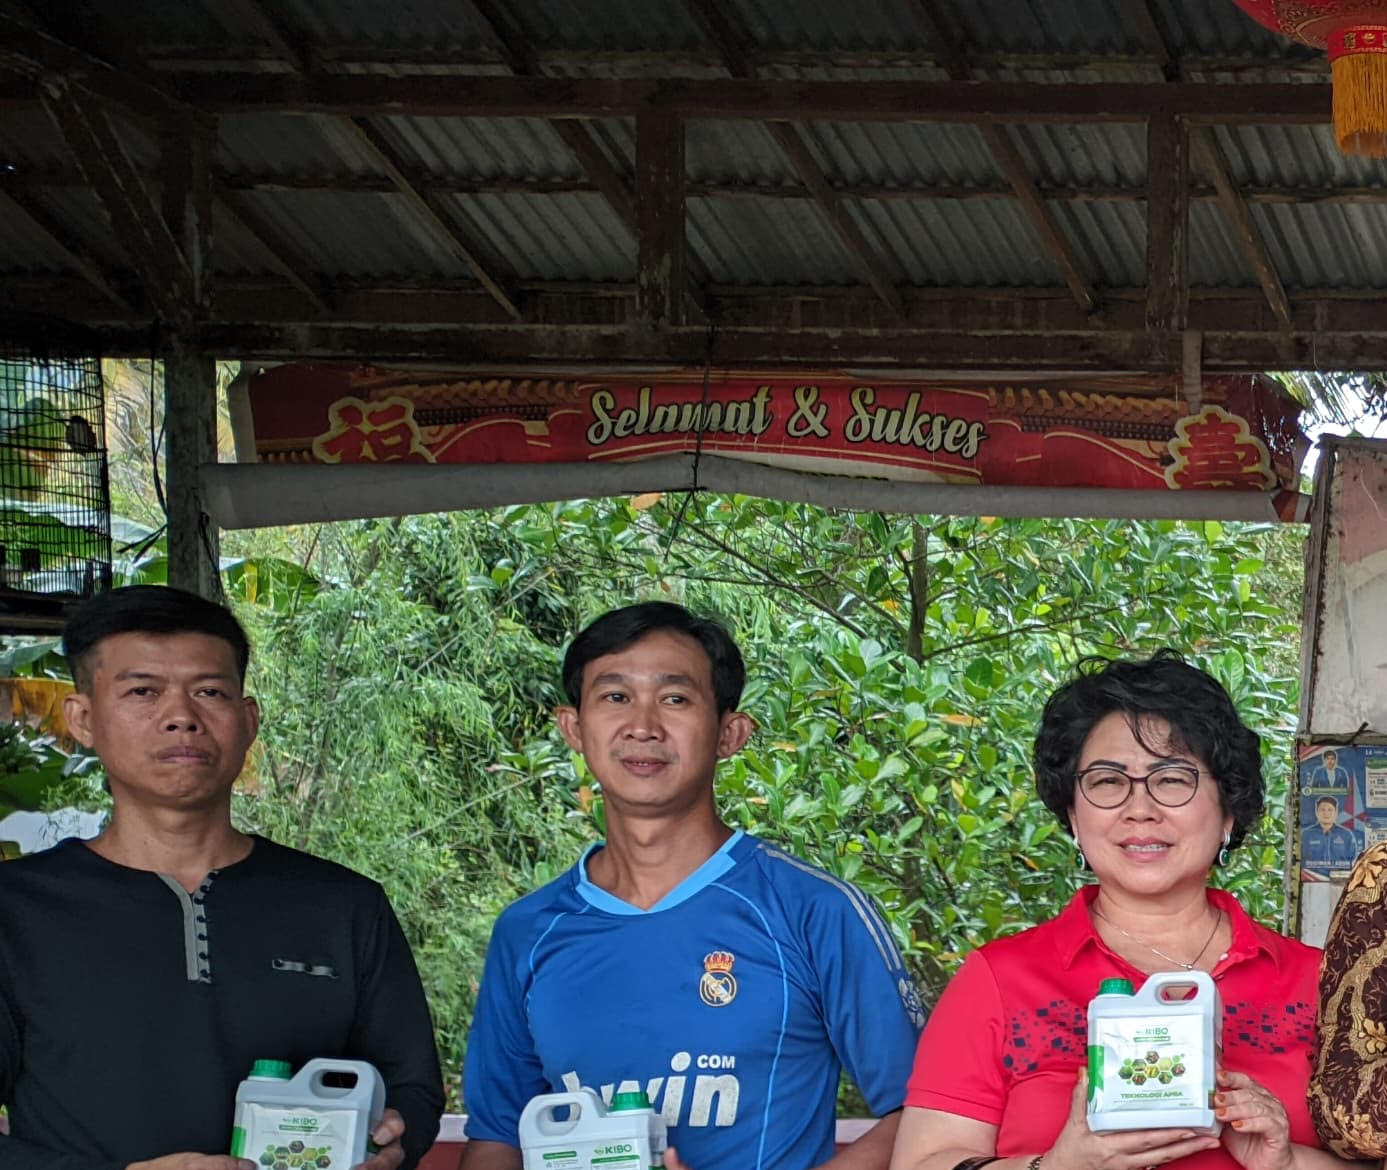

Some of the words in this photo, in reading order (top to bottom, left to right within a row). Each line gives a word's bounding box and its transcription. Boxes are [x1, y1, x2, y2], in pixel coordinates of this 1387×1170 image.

[587, 386, 775, 446] Selamat
[787, 386, 829, 438] &
[846, 386, 988, 459] Sukses
[697, 1054, 736, 1069] COM
[604, 1143, 633, 1155] KIBO
